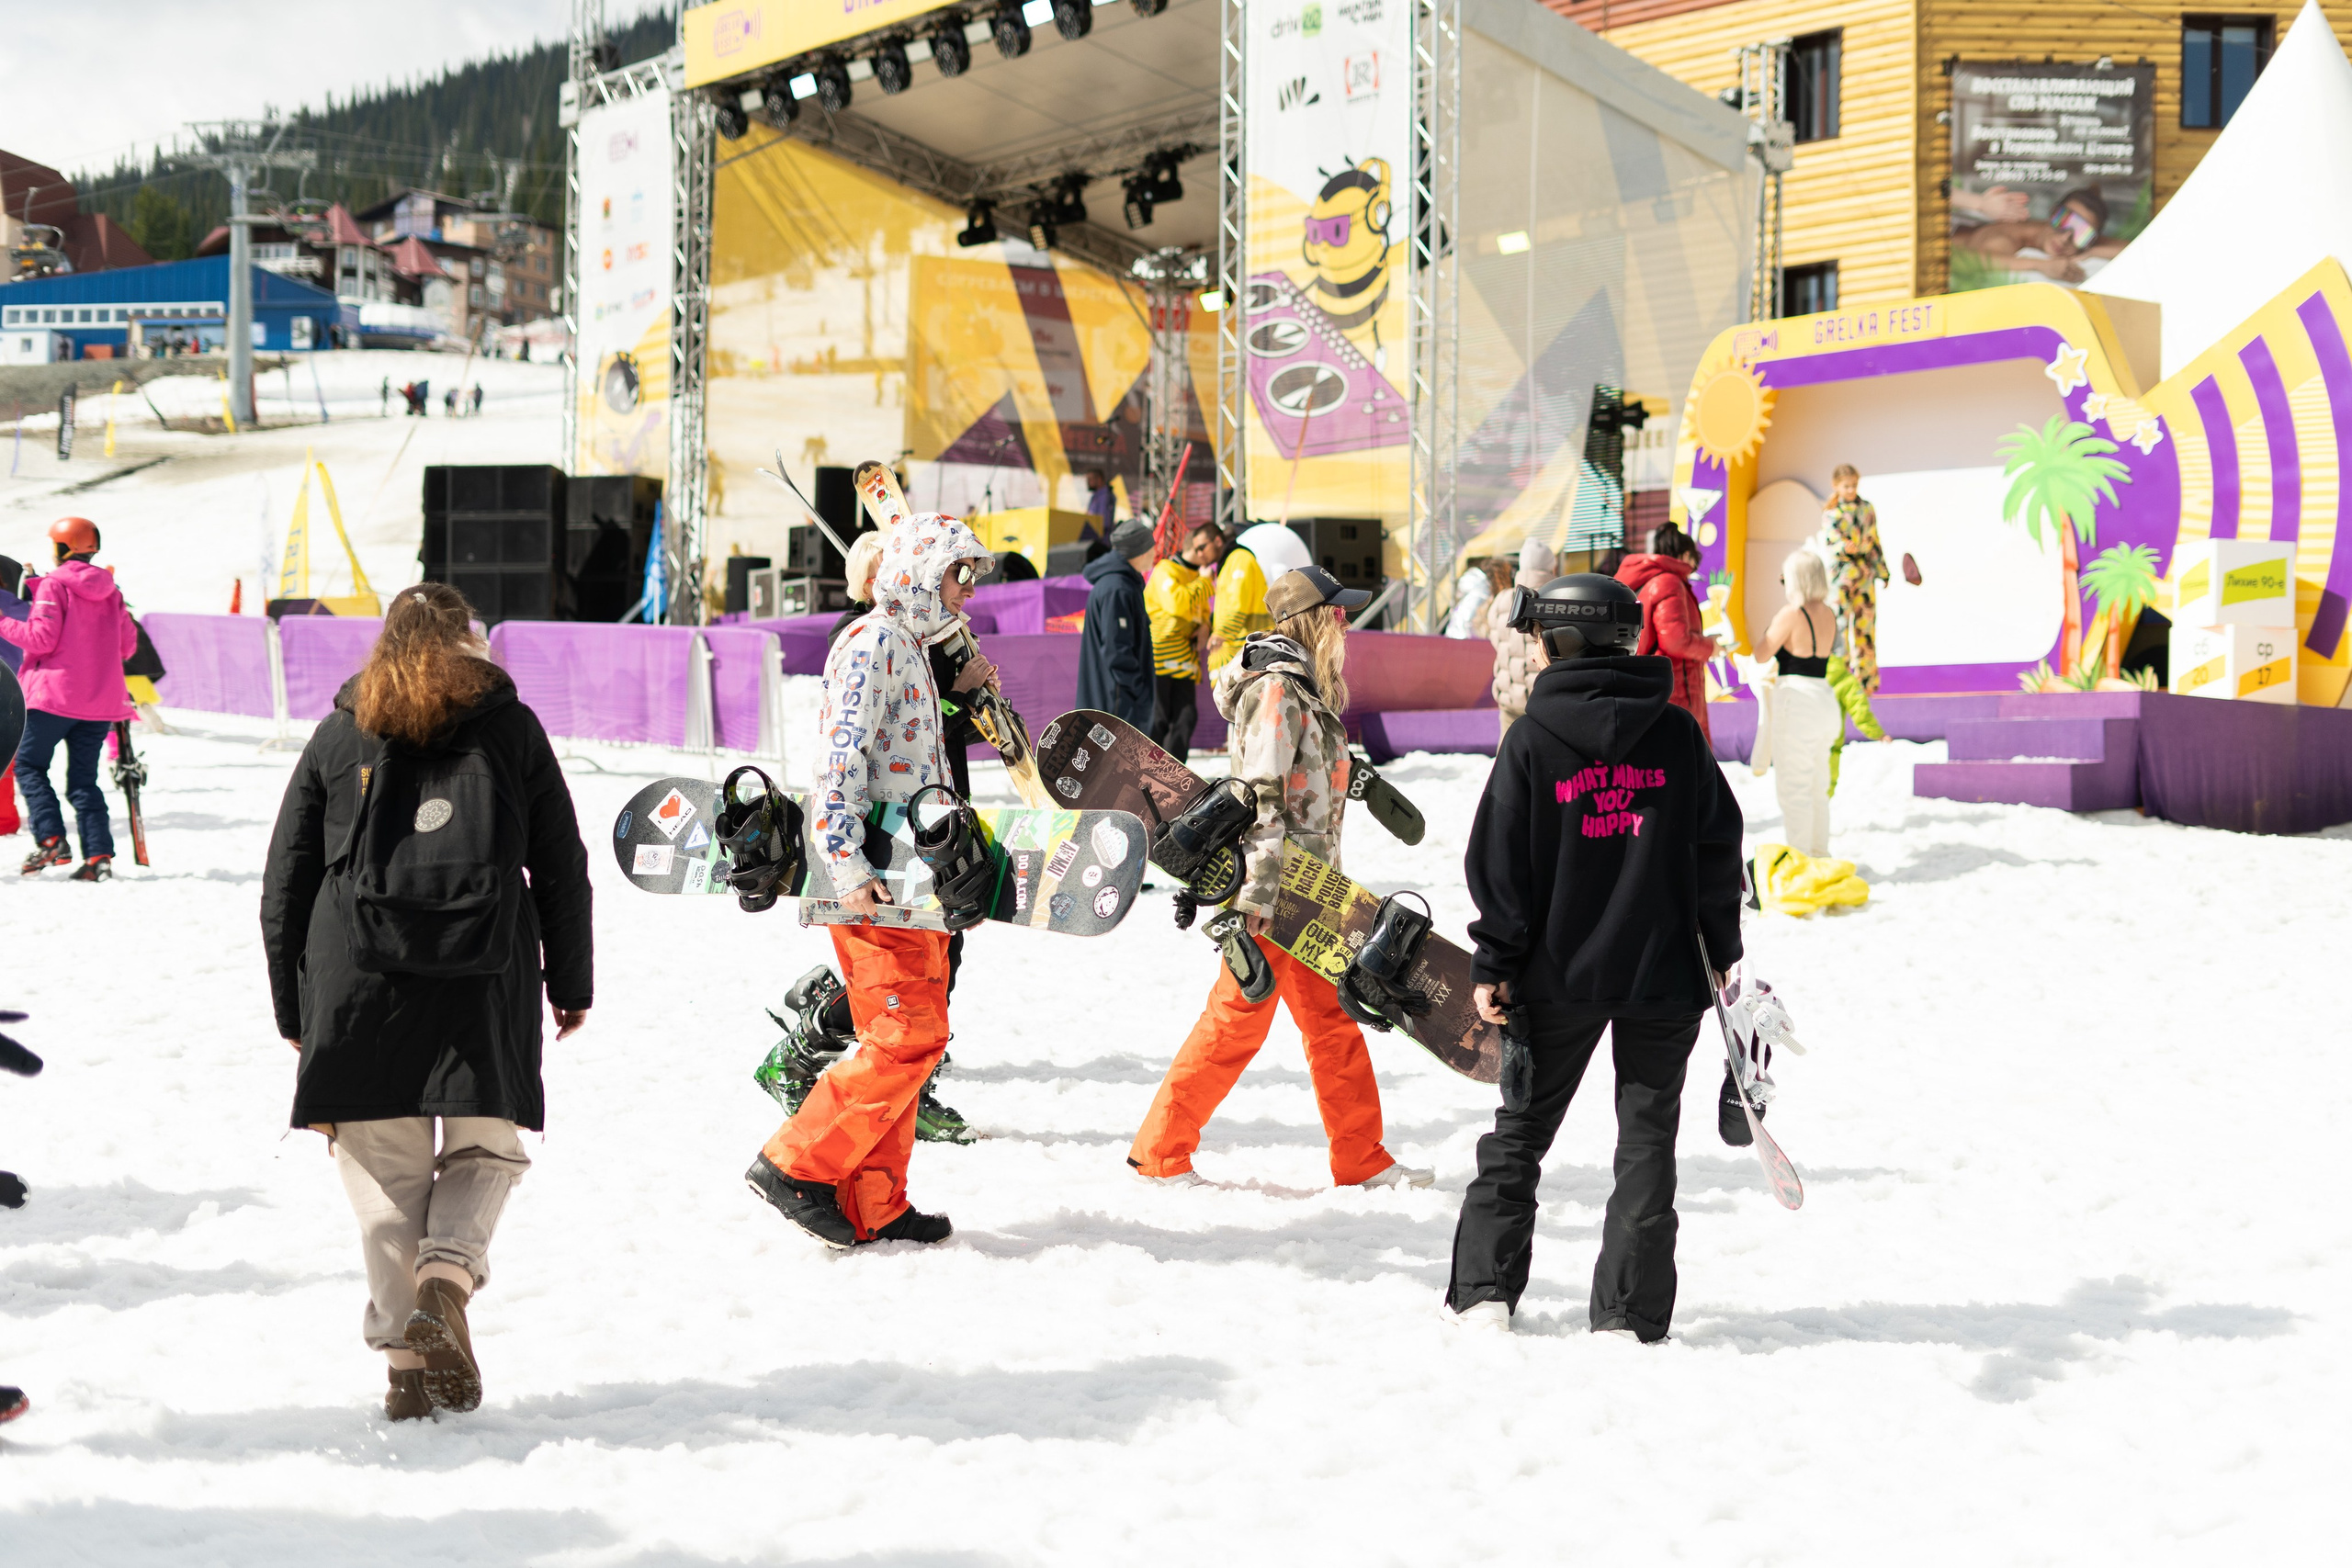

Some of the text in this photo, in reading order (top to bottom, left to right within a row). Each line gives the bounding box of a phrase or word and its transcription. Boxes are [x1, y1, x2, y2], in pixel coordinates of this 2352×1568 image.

[2007, 95, 2098, 111] СПА-МАССАЖ
[1815, 304, 1933, 344] GRELKA FEST
[2227, 574, 2285, 590] Лихие 90-е
[2256, 642, 2274, 661] ср
[2192, 667, 2210, 686] 20
[2257, 667, 2272, 685] 17
[1555, 763, 1667, 804] WHAT MAKES
[1593, 788, 1635, 814] YOU
[1581, 811, 1644, 839] HAPPY
[1097, 825, 1119, 866] FREERIDE
[1295, 855, 1324, 895] RACIS
[1306, 922, 1340, 951] OUR
[1300, 940, 1326, 962] MY
[1431, 983, 1453, 1008] XXX
